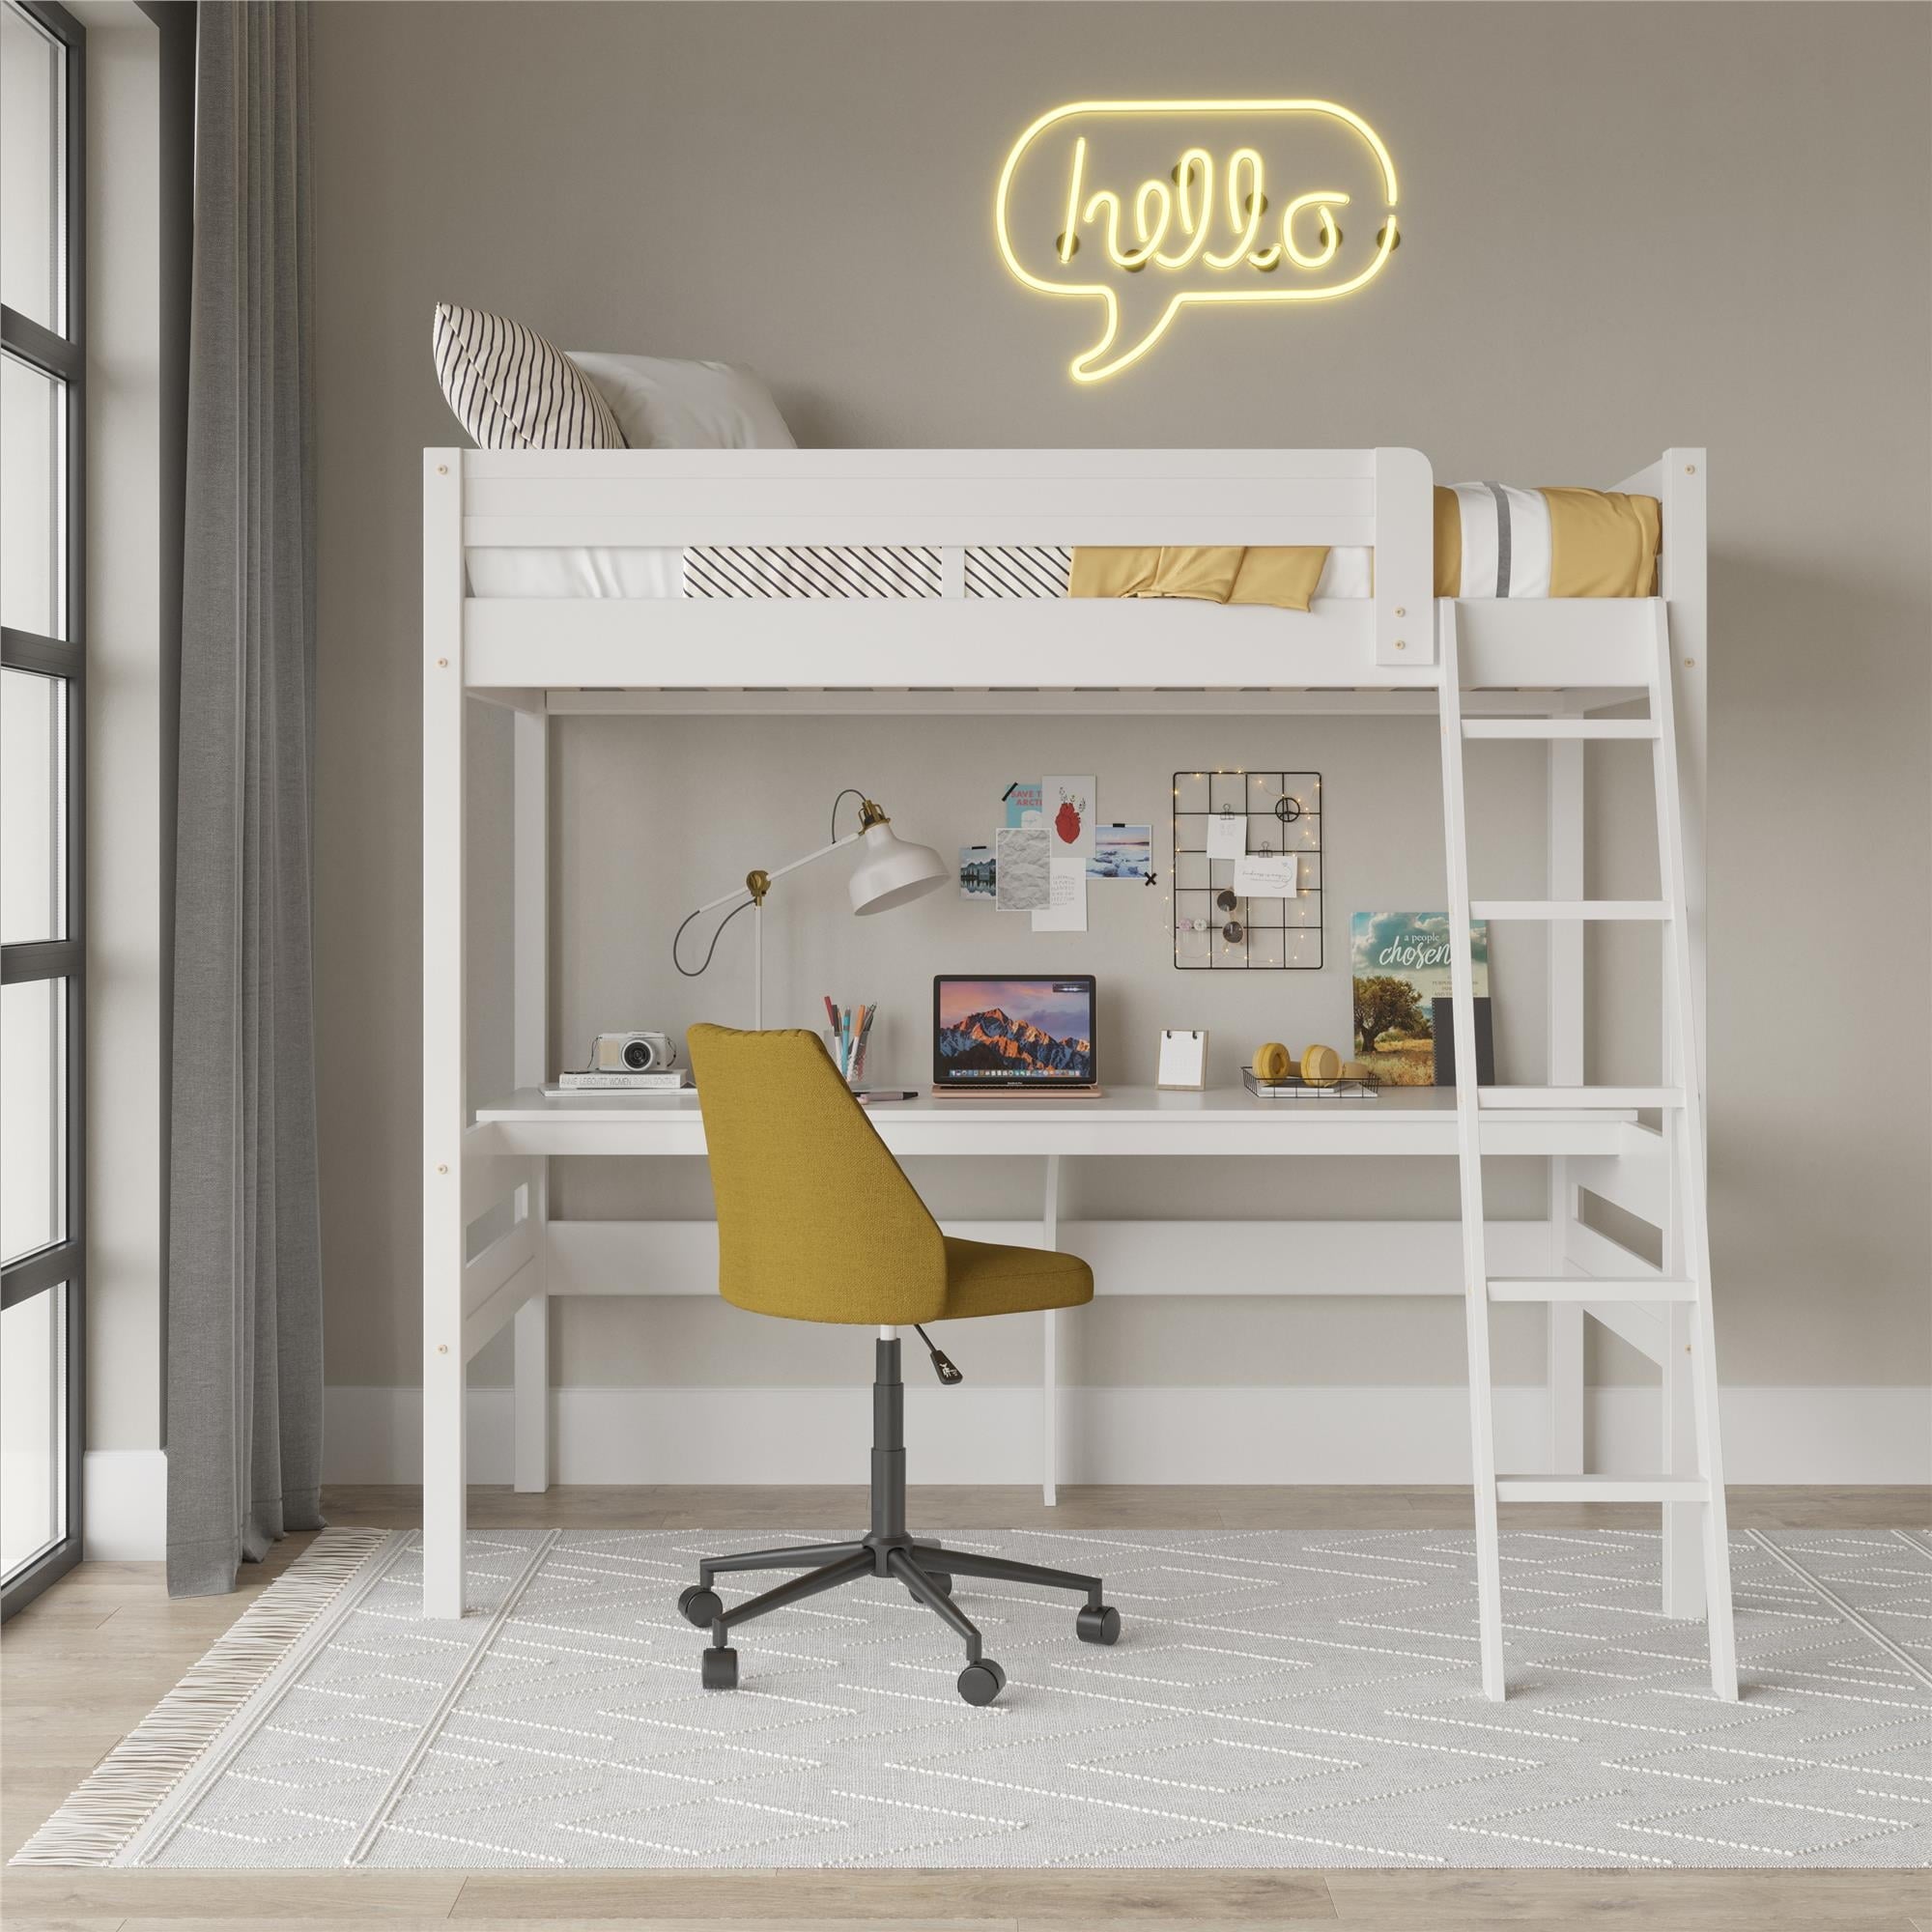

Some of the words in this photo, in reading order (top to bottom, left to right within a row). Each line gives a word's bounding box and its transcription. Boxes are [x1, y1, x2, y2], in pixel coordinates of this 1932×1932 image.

[1059, 136, 1350, 270] hello
[1411, 931, 1439, 944] people
[1378, 935, 1452, 970] chosen
[610, 1077, 632, 1086] WOMEN
